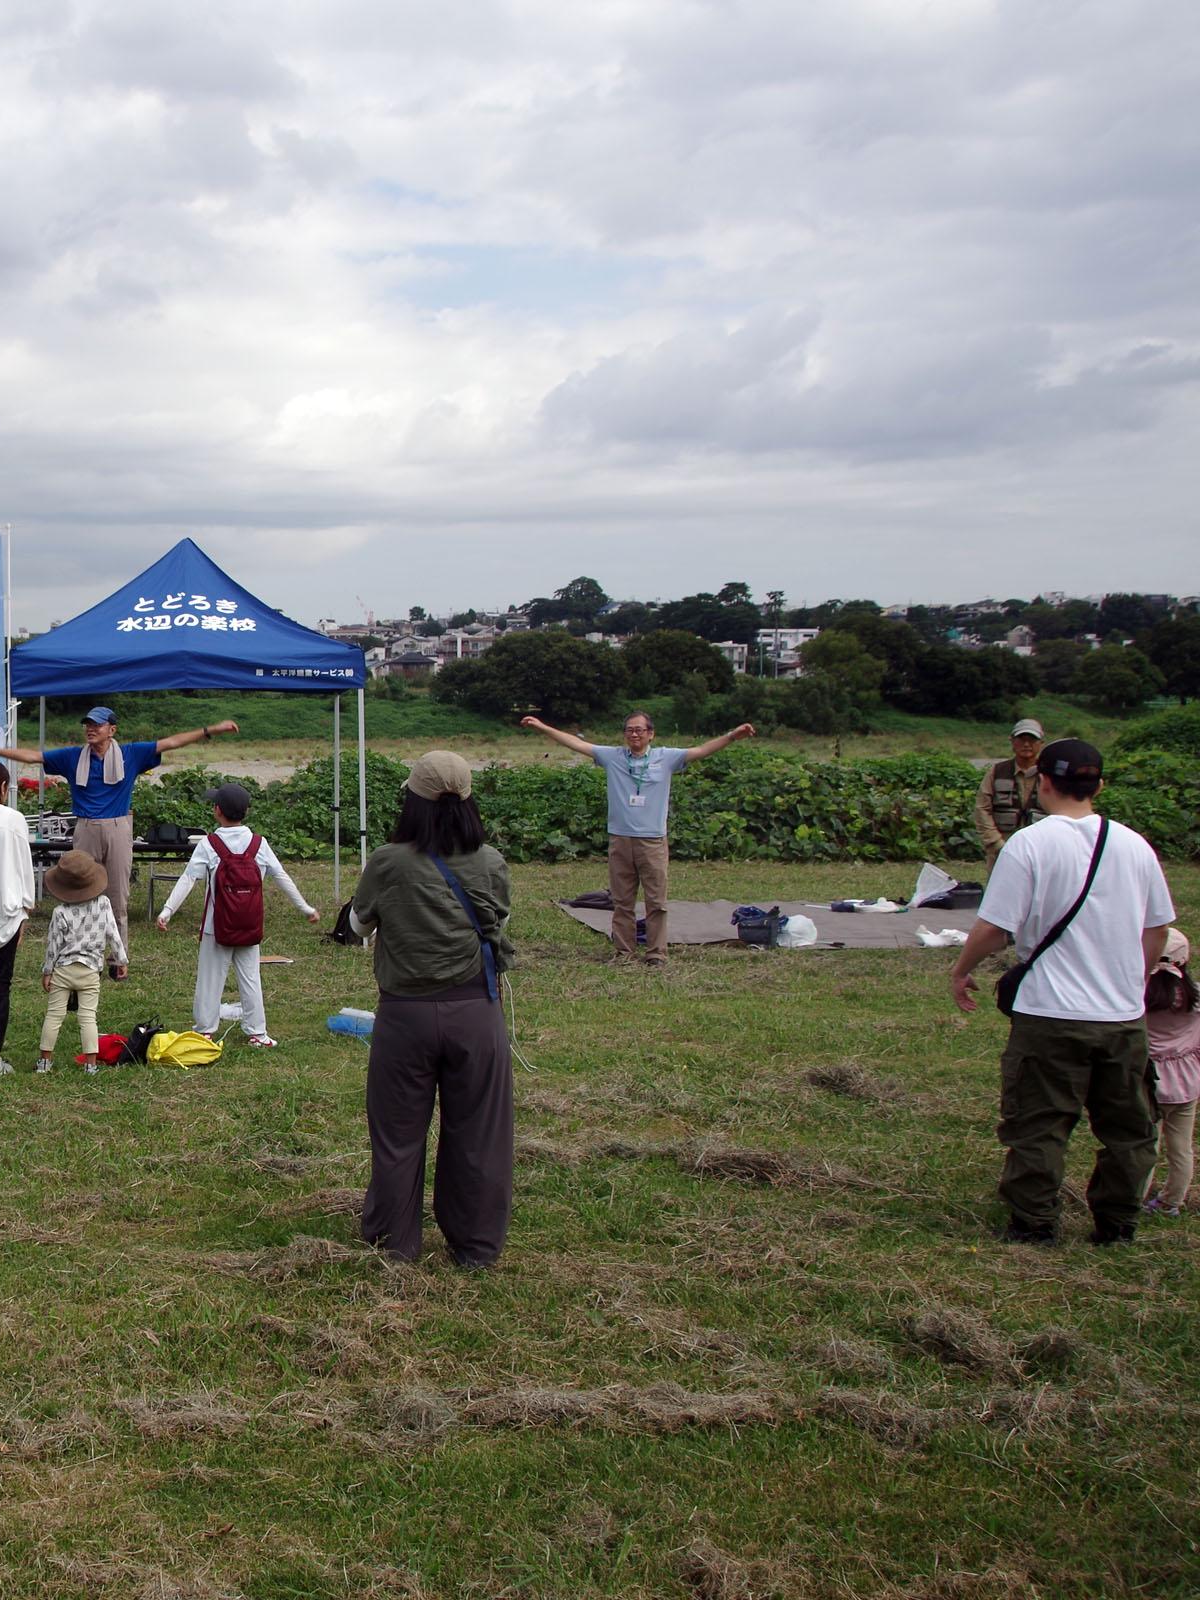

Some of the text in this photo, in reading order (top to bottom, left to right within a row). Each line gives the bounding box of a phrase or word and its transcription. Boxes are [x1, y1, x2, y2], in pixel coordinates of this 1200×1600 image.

[134, 592, 238, 614] とどろき
[116, 613, 257, 632] 水辺の楽校
